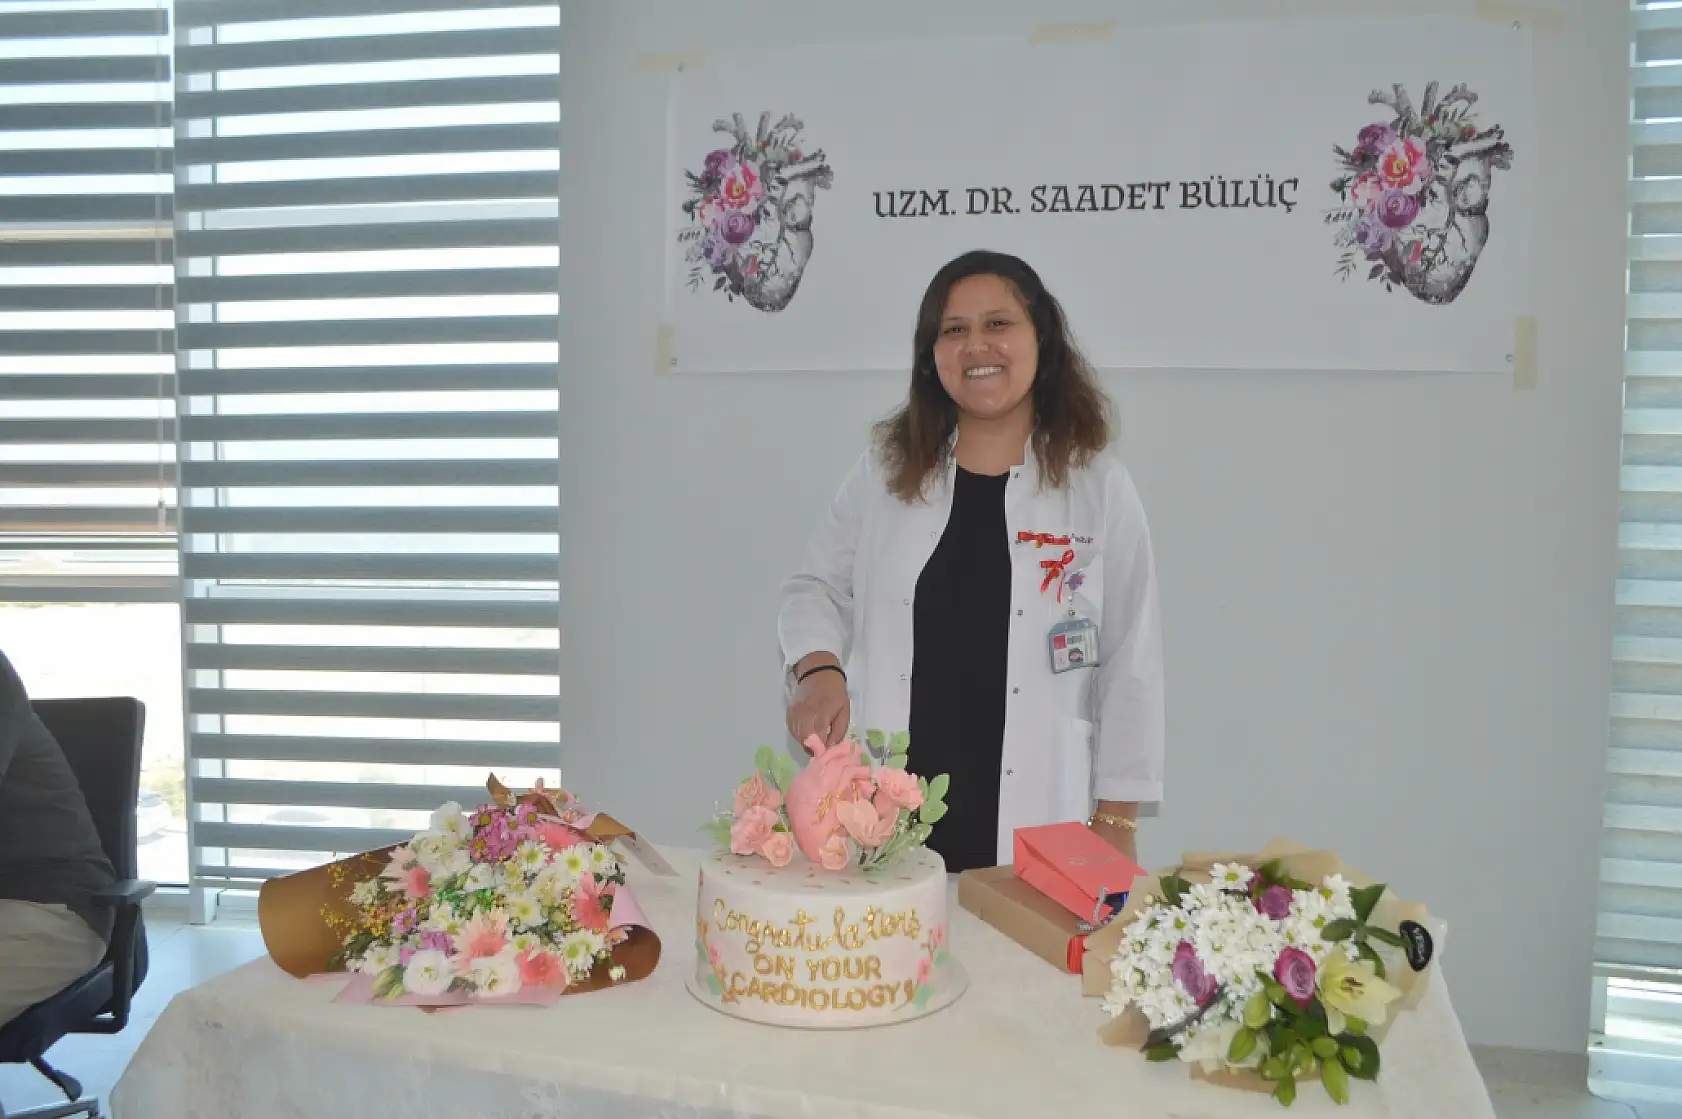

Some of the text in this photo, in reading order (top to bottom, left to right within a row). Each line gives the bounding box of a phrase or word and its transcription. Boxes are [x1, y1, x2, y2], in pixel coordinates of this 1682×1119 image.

[873, 174, 1299, 218] UZM. DR. SAADET BÜLÜÇ
[714, 898, 921, 954] Congratulations
[753, 953, 882, 982] ON YOUR
